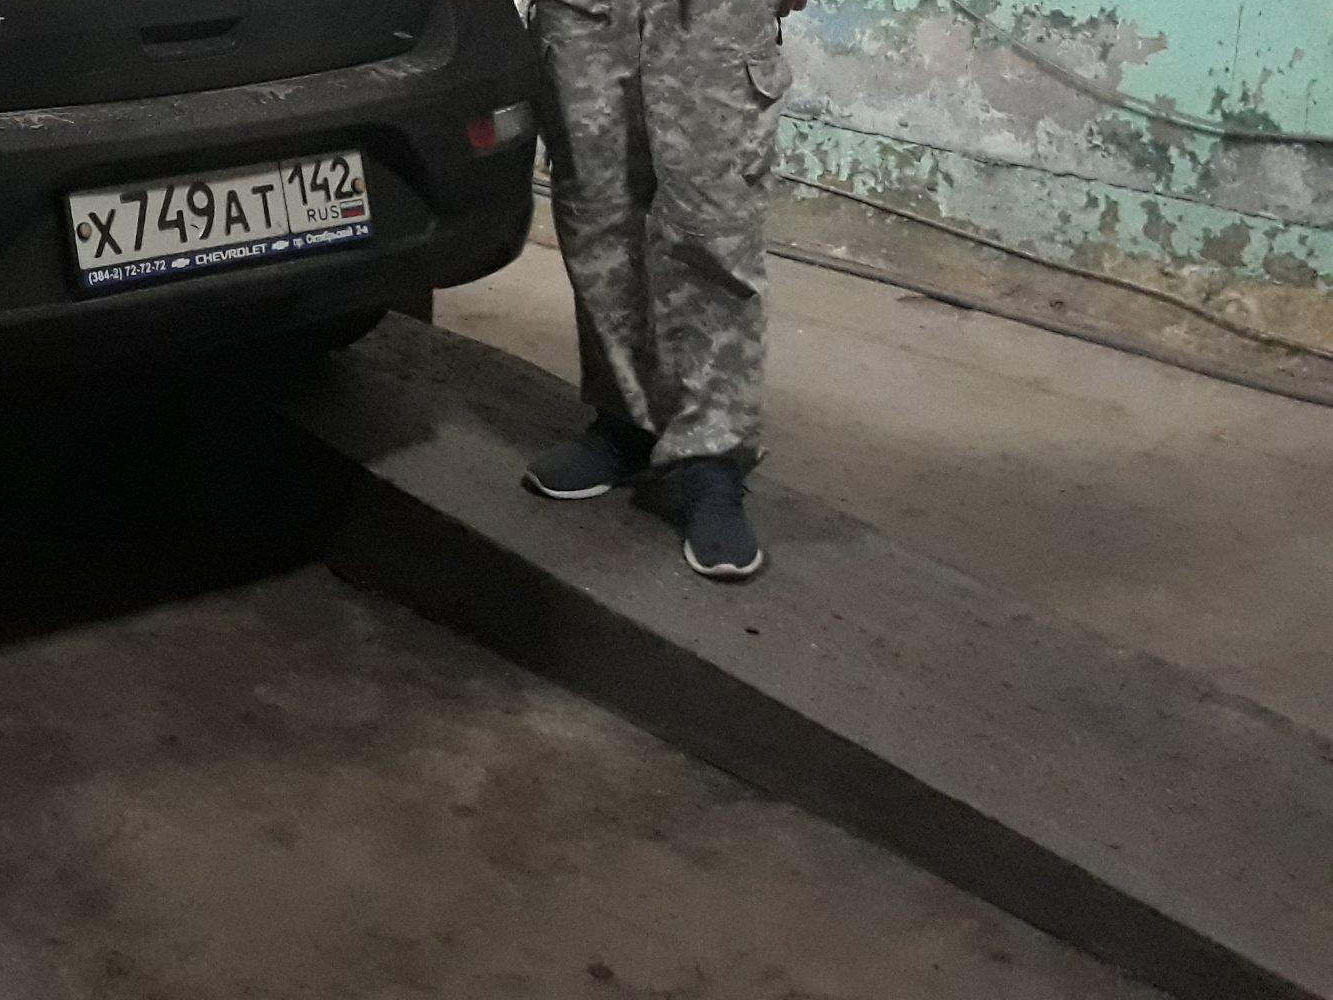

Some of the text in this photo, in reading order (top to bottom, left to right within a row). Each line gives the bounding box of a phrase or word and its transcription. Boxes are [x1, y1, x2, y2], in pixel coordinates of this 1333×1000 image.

[88, 155, 355, 259] Х749АТ 142
[306, 204, 340, 223] RUS
[88, 265, 124, 286] (384-2)
[125, 259, 167, 278] 72-72-72
[195, 243, 267, 266] CHEVROLET
